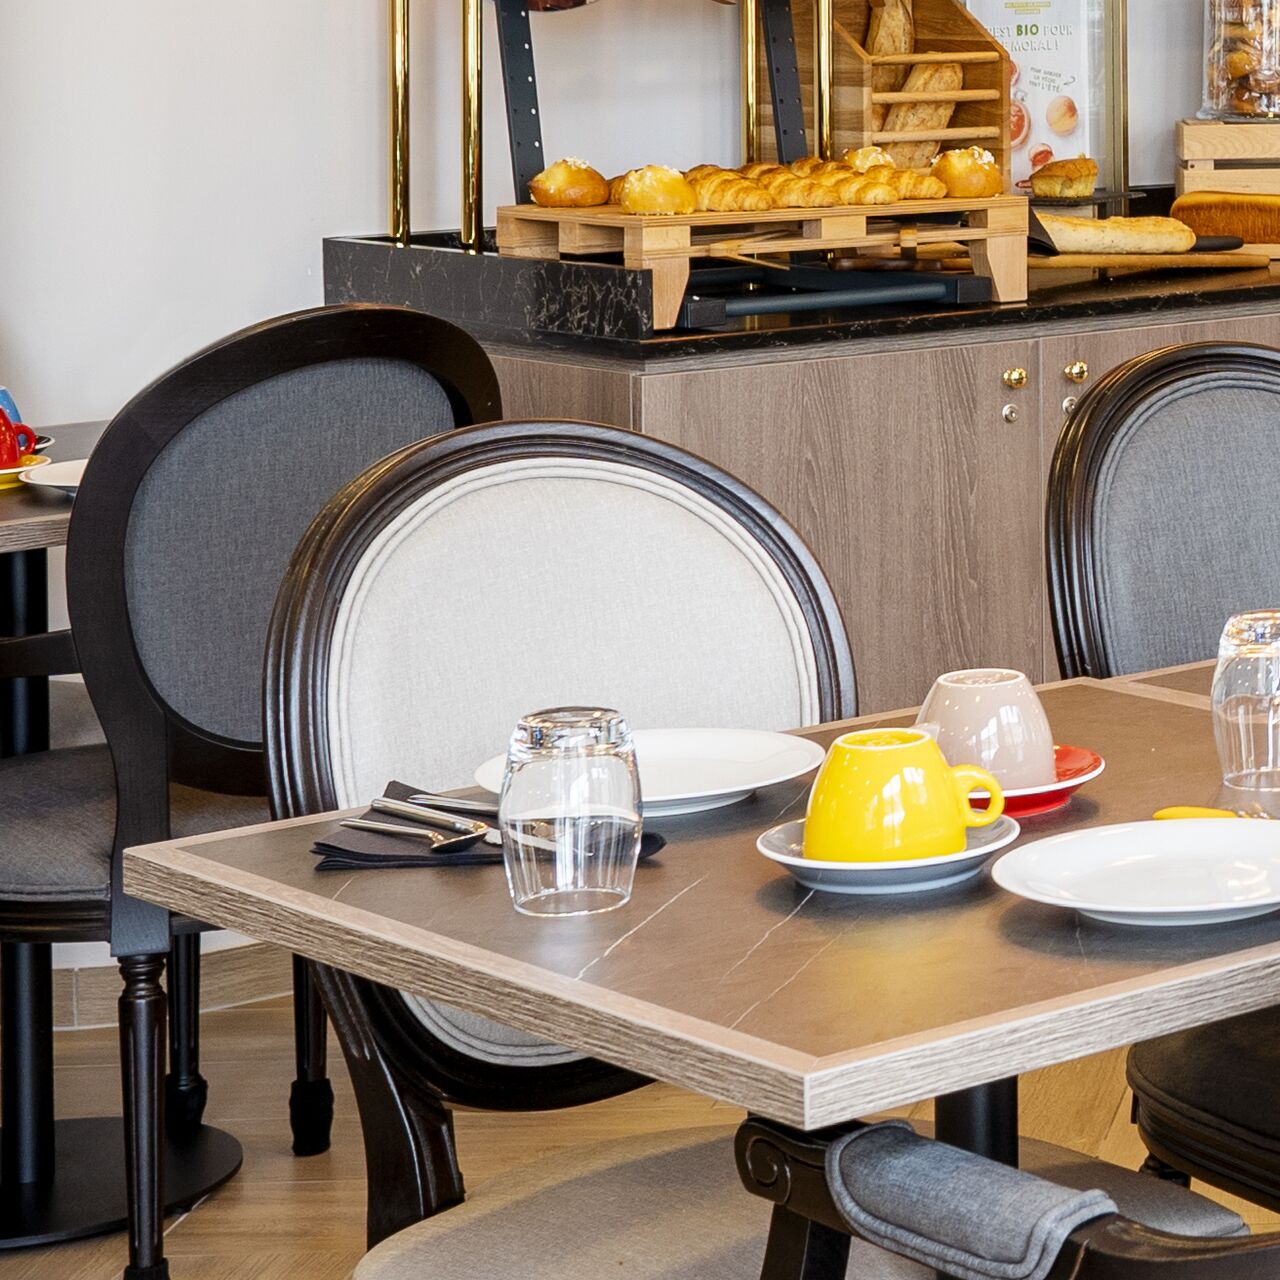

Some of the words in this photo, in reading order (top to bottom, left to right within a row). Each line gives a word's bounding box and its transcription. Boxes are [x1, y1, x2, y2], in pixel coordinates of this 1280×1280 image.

[1016, 23, 1039, 37] BIO
[1043, 24, 1073, 36] POUR
[1010, 39, 1051, 52] MORAL
